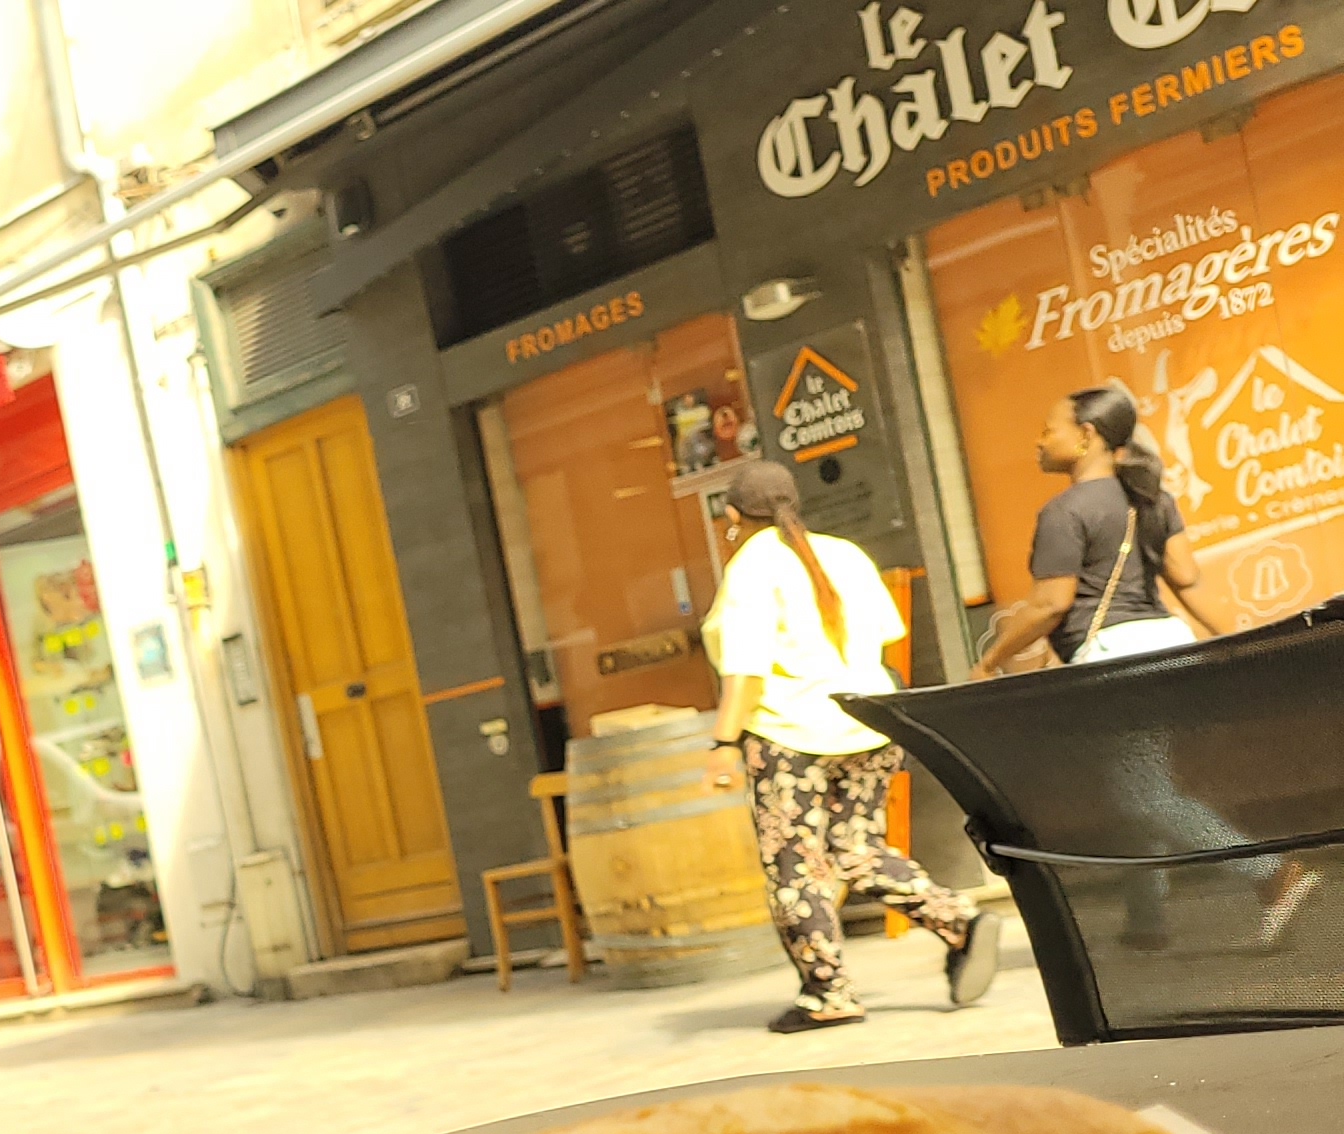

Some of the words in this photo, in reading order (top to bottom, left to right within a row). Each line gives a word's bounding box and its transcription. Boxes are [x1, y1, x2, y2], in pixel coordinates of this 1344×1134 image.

[858, 1, 925, 70] le
[757, 0, 1073, 197] Chalet
[926, 108, 1098, 197] PRODUITS
[1110, 24, 1306, 126] FERMIERS
[1024, 211, 1341, 350] Fromagères
[1090, 206, 1239, 284] Spécialités
[505, 290, 645, 365] FROMAGES
[1107, 313, 1186, 354] depuis
[1218, 282, 1274, 321] 1872
[784, 388, 852, 427] Chalet
[1216, 404, 1325, 470] Chalet
